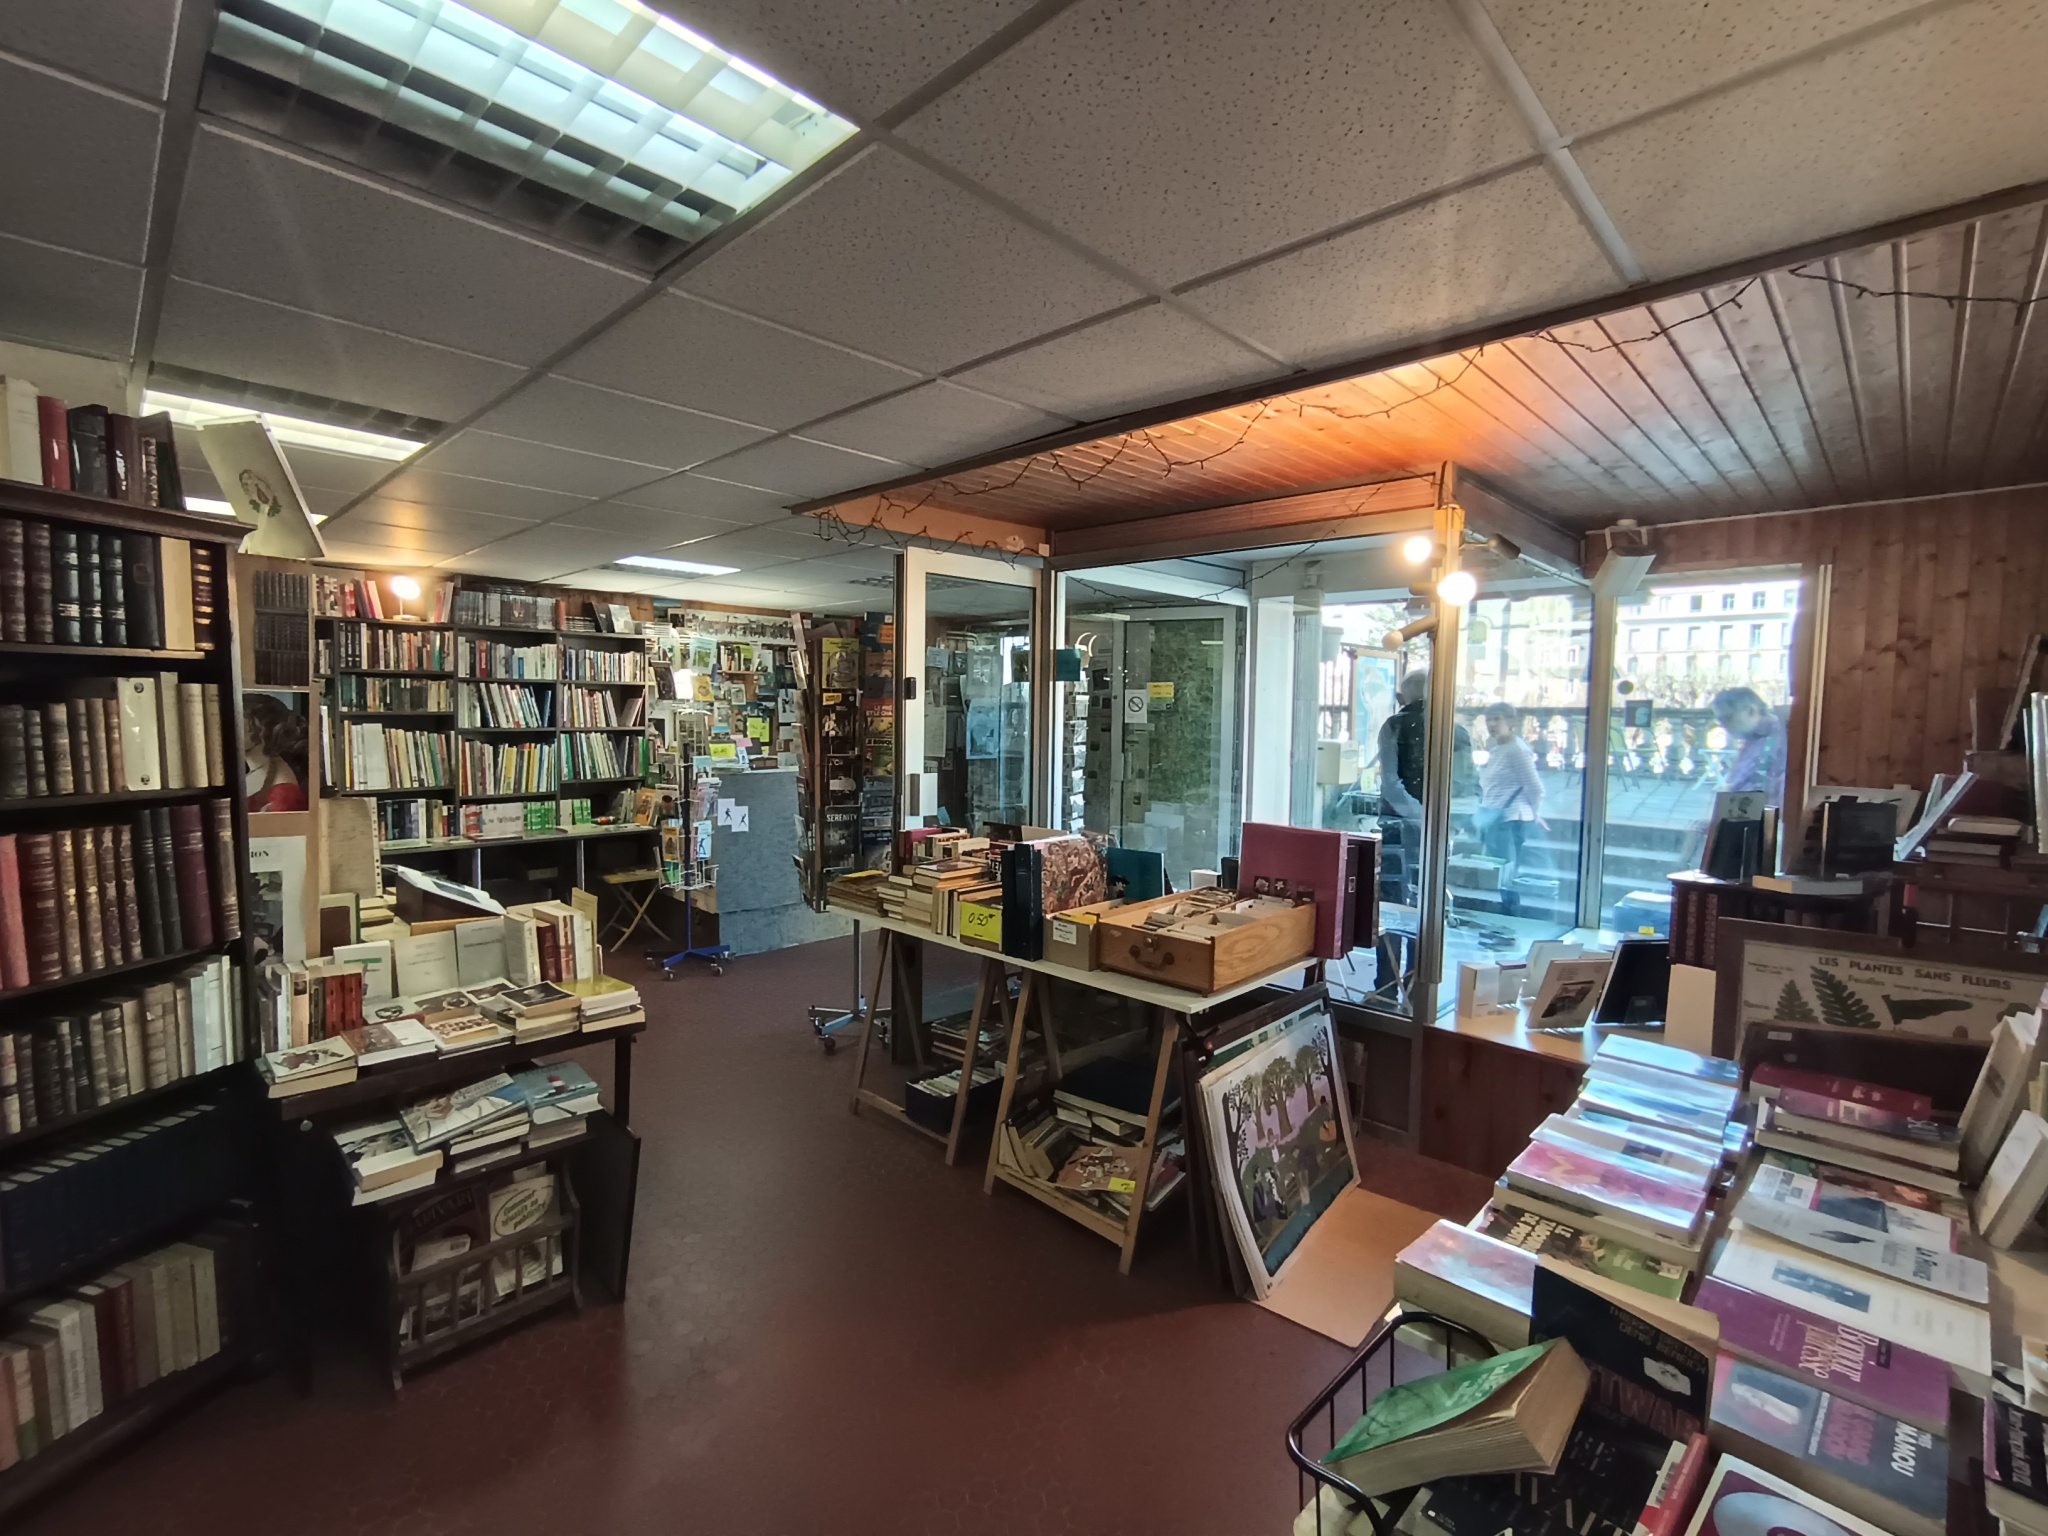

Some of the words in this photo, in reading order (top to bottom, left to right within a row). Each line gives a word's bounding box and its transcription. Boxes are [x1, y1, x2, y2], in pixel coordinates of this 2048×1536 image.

[826, 814, 857, 822] SERENITY
[1818, 956, 1839, 967] LES
[1849, 959, 1903, 976] PLANTES
[1914, 968, 1952, 983] SANS
[1961, 974, 2012, 991] FLEURS
[1554, 1223, 1574, 1239] LE
[1618, 1322, 1651, 1346] DENIS
[1796, 1320, 1837, 1379] paresse
[1831, 1324, 1879, 1382] Bonjour
[1890, 1420, 1918, 1478] MAMOU
